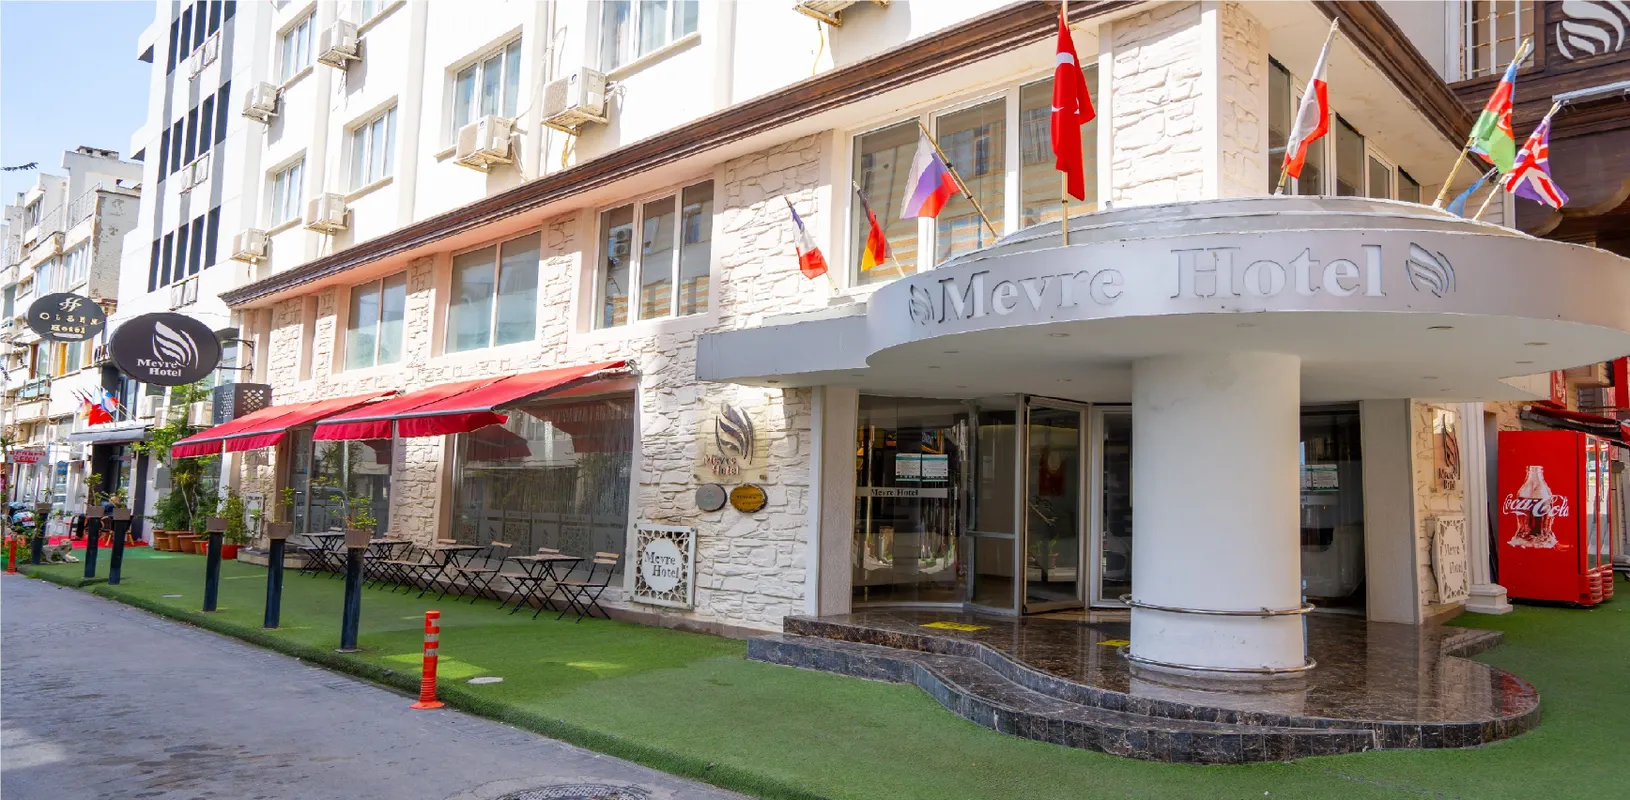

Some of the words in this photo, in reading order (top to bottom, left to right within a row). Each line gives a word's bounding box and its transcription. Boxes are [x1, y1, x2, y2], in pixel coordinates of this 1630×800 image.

[938, 267, 1125, 323] Mevre
[1170, 244, 1387, 299] Hotel
[50, 324, 86, 334] Hotel
[136, 358, 178, 369] Mevre
[149, 367, 182, 377] Hotel
[1502, 494, 1569, 517] Coca-Cola
[645, 551, 676, 565] Mevre
[652, 565, 680, 579] Hotel
